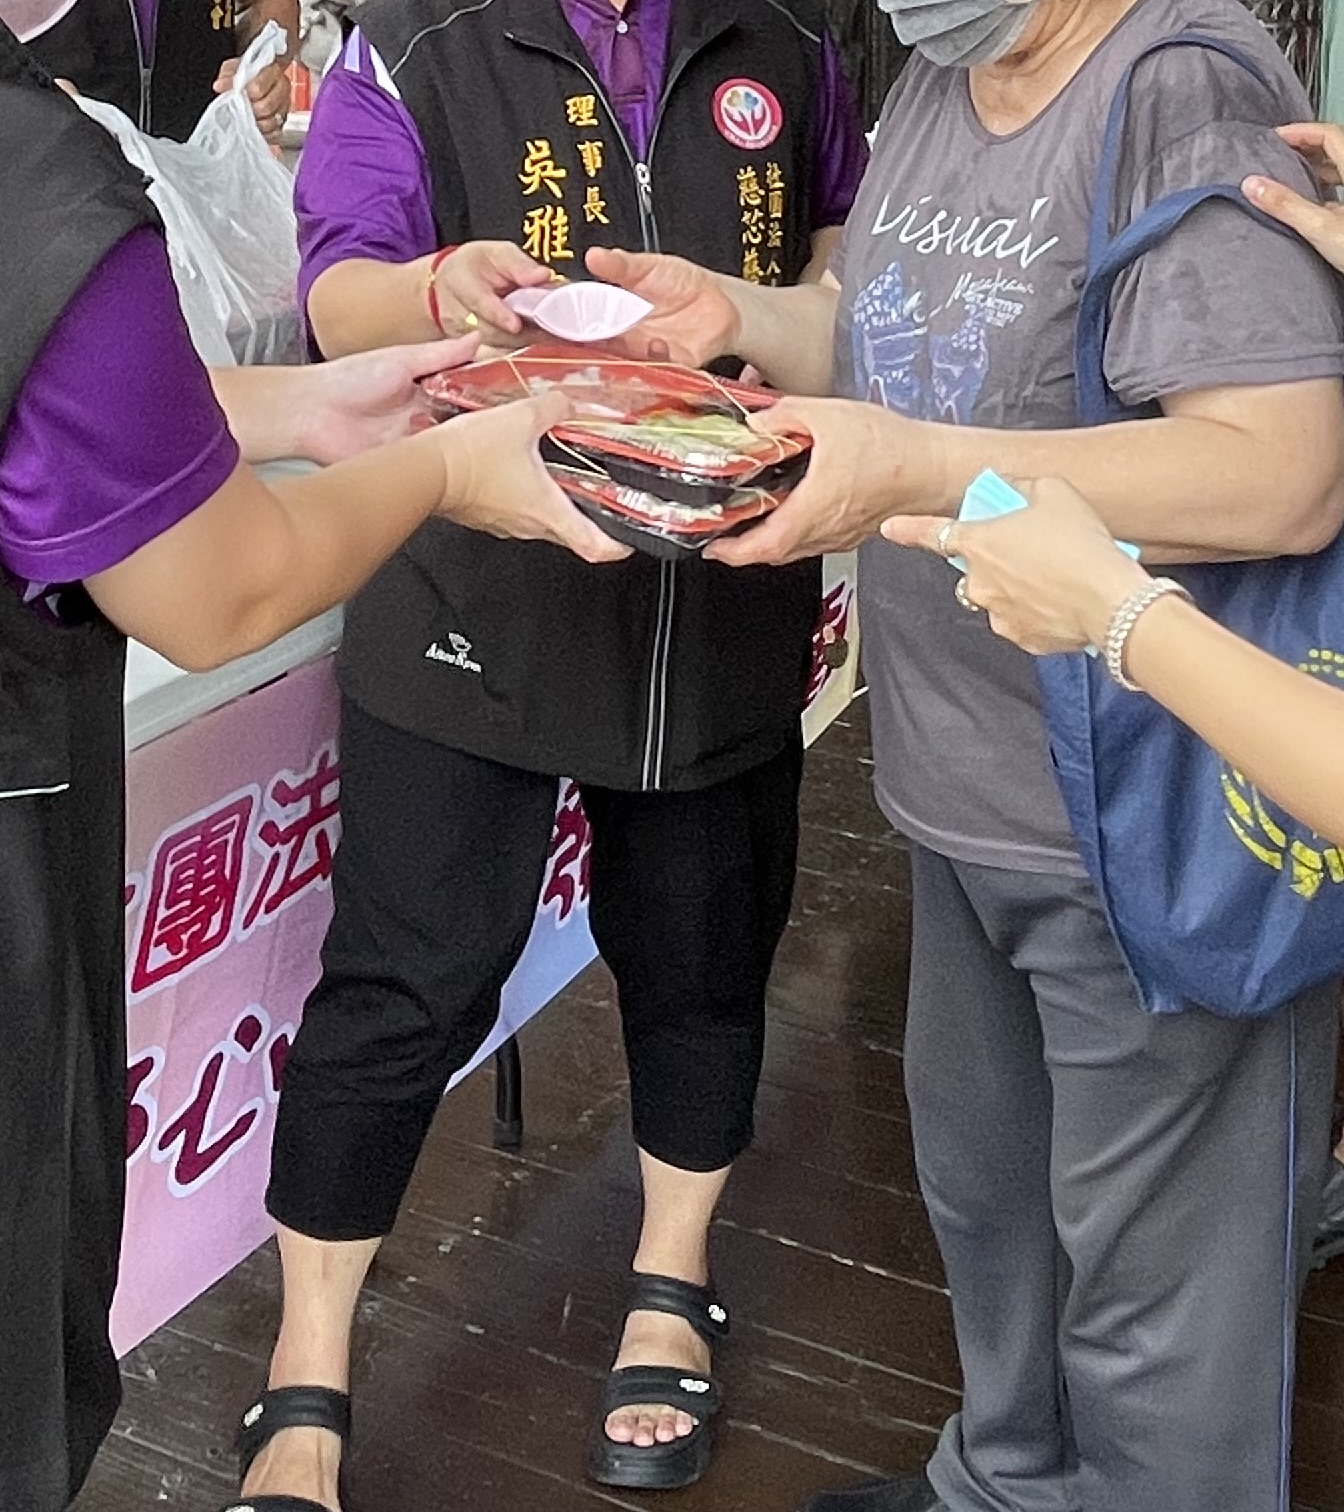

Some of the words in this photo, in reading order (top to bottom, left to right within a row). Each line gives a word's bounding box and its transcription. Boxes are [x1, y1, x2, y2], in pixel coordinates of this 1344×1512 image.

[518, 139, 575, 274] 吳雅
[565, 94, 610, 225] 理事長
[766, 161, 786, 287] 社團法人
[126, 748, 342, 993] 團法
